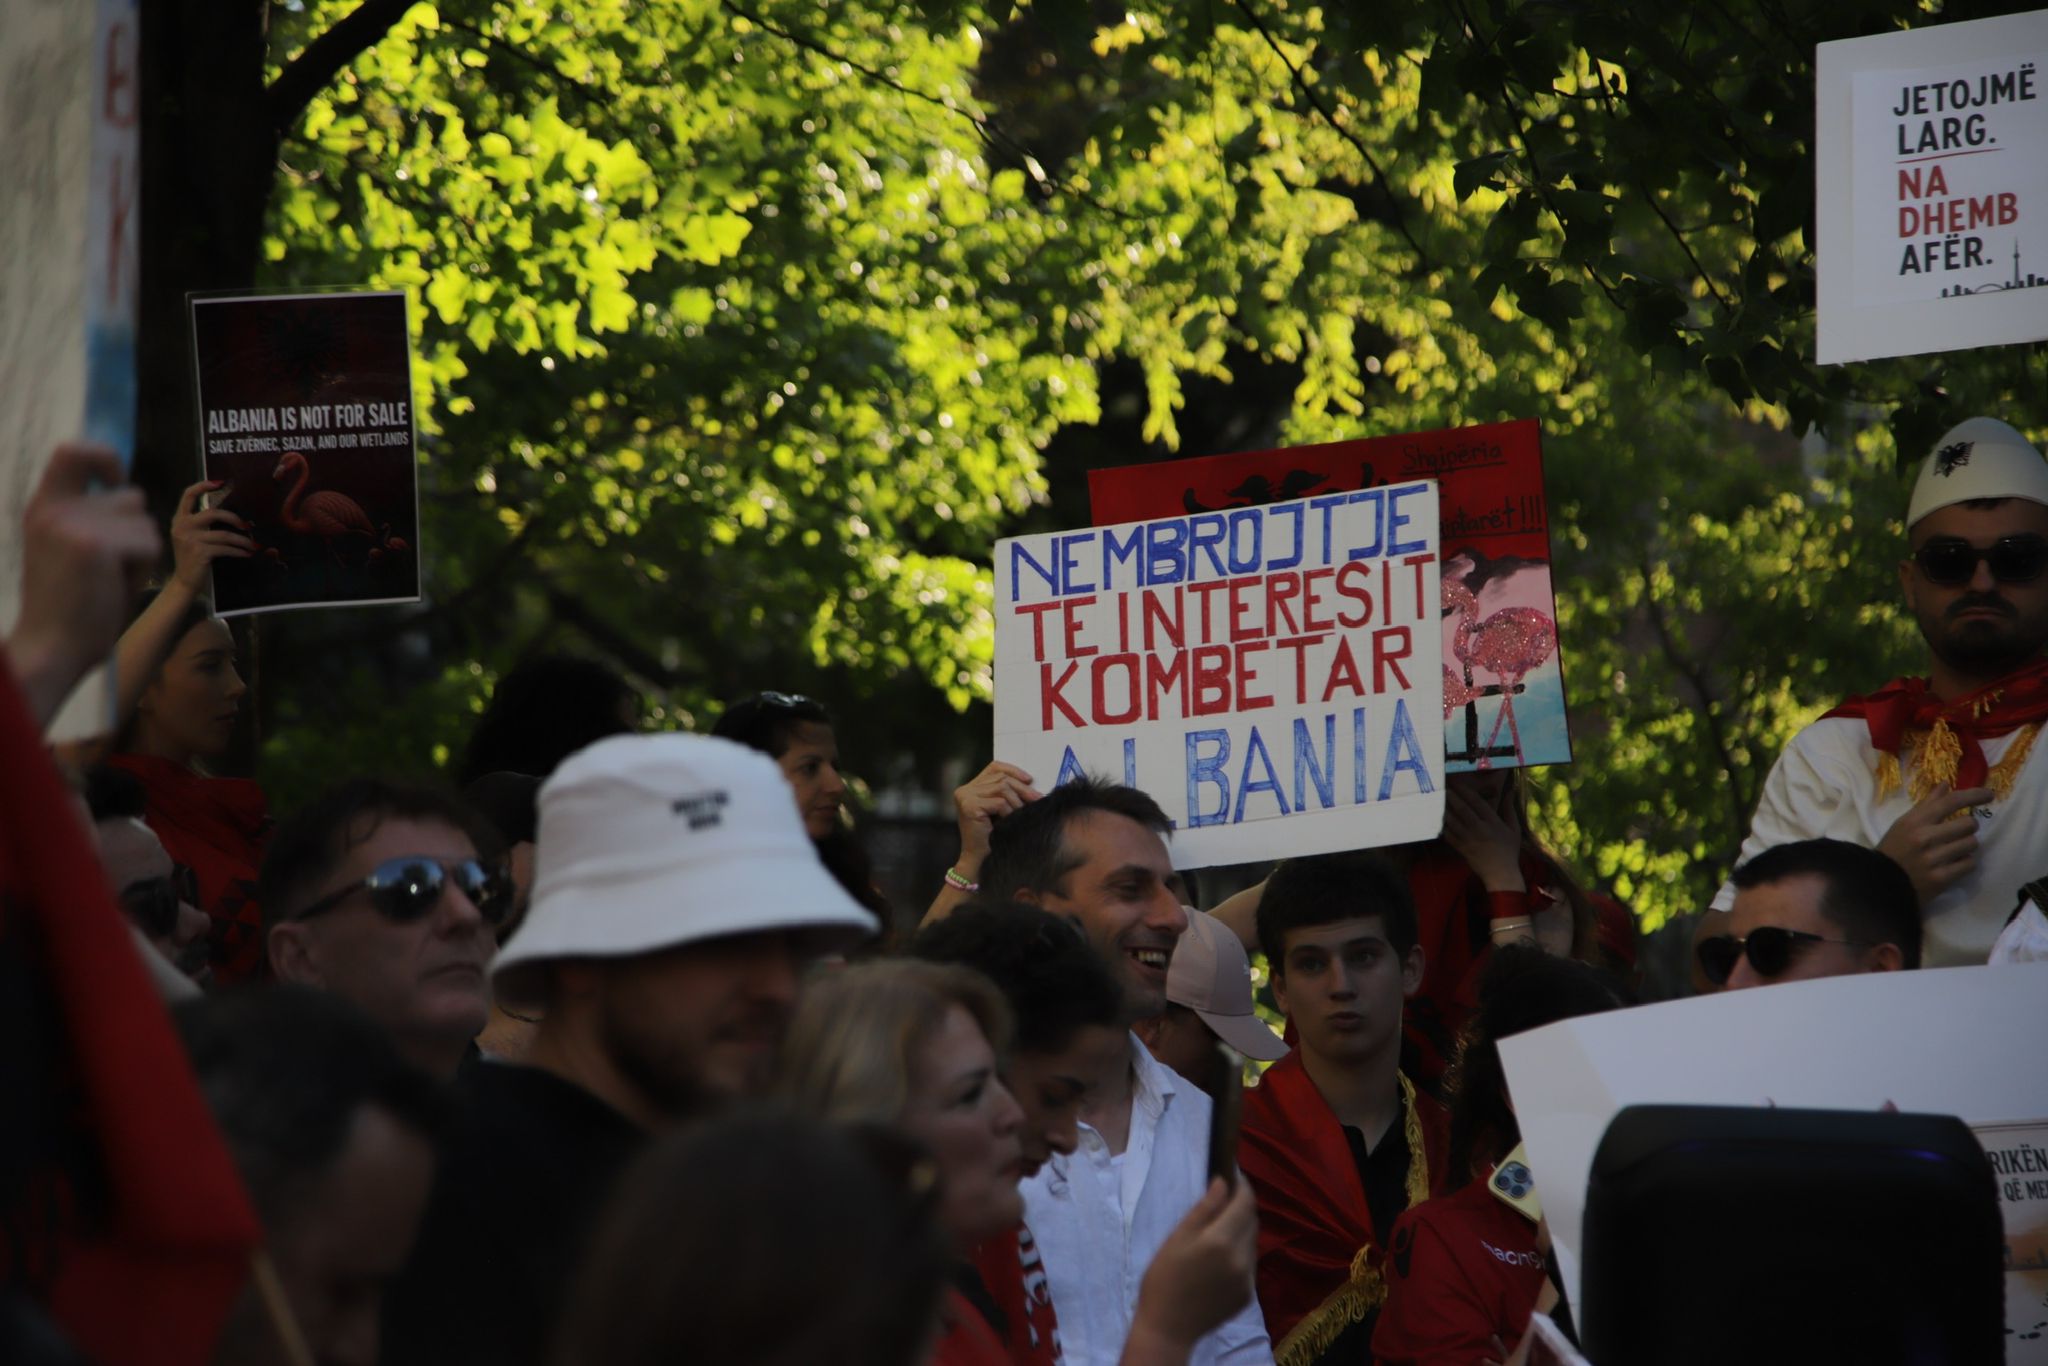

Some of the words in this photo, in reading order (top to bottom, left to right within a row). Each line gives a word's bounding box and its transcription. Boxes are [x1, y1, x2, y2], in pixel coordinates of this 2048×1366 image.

[1893, 62, 2037, 117] JETOJMË
[1898, 113, 1996, 155] LARG.
[1898, 165, 1949, 201] NA
[1898, 192, 2019, 239] DHEMB
[1899, 232, 1993, 276] AFËR.
[208, 407, 279, 434] ALBANIA
[281, 406, 298, 431] IS
[300, 405, 331, 430] NOT
[334, 403, 366, 428] FOR
[368, 401, 408, 427] SALE
[209, 438, 235, 455] SAVE
[281, 435, 317, 452] SAZAN,
[317, 434, 338, 449] AND
[338, 433, 359, 448] OUR
[359, 430, 409, 448] WETLANDS
[1040, 626, 1413, 731] KOMBETAR
[2025, 1180, 2048, 1201] ME
